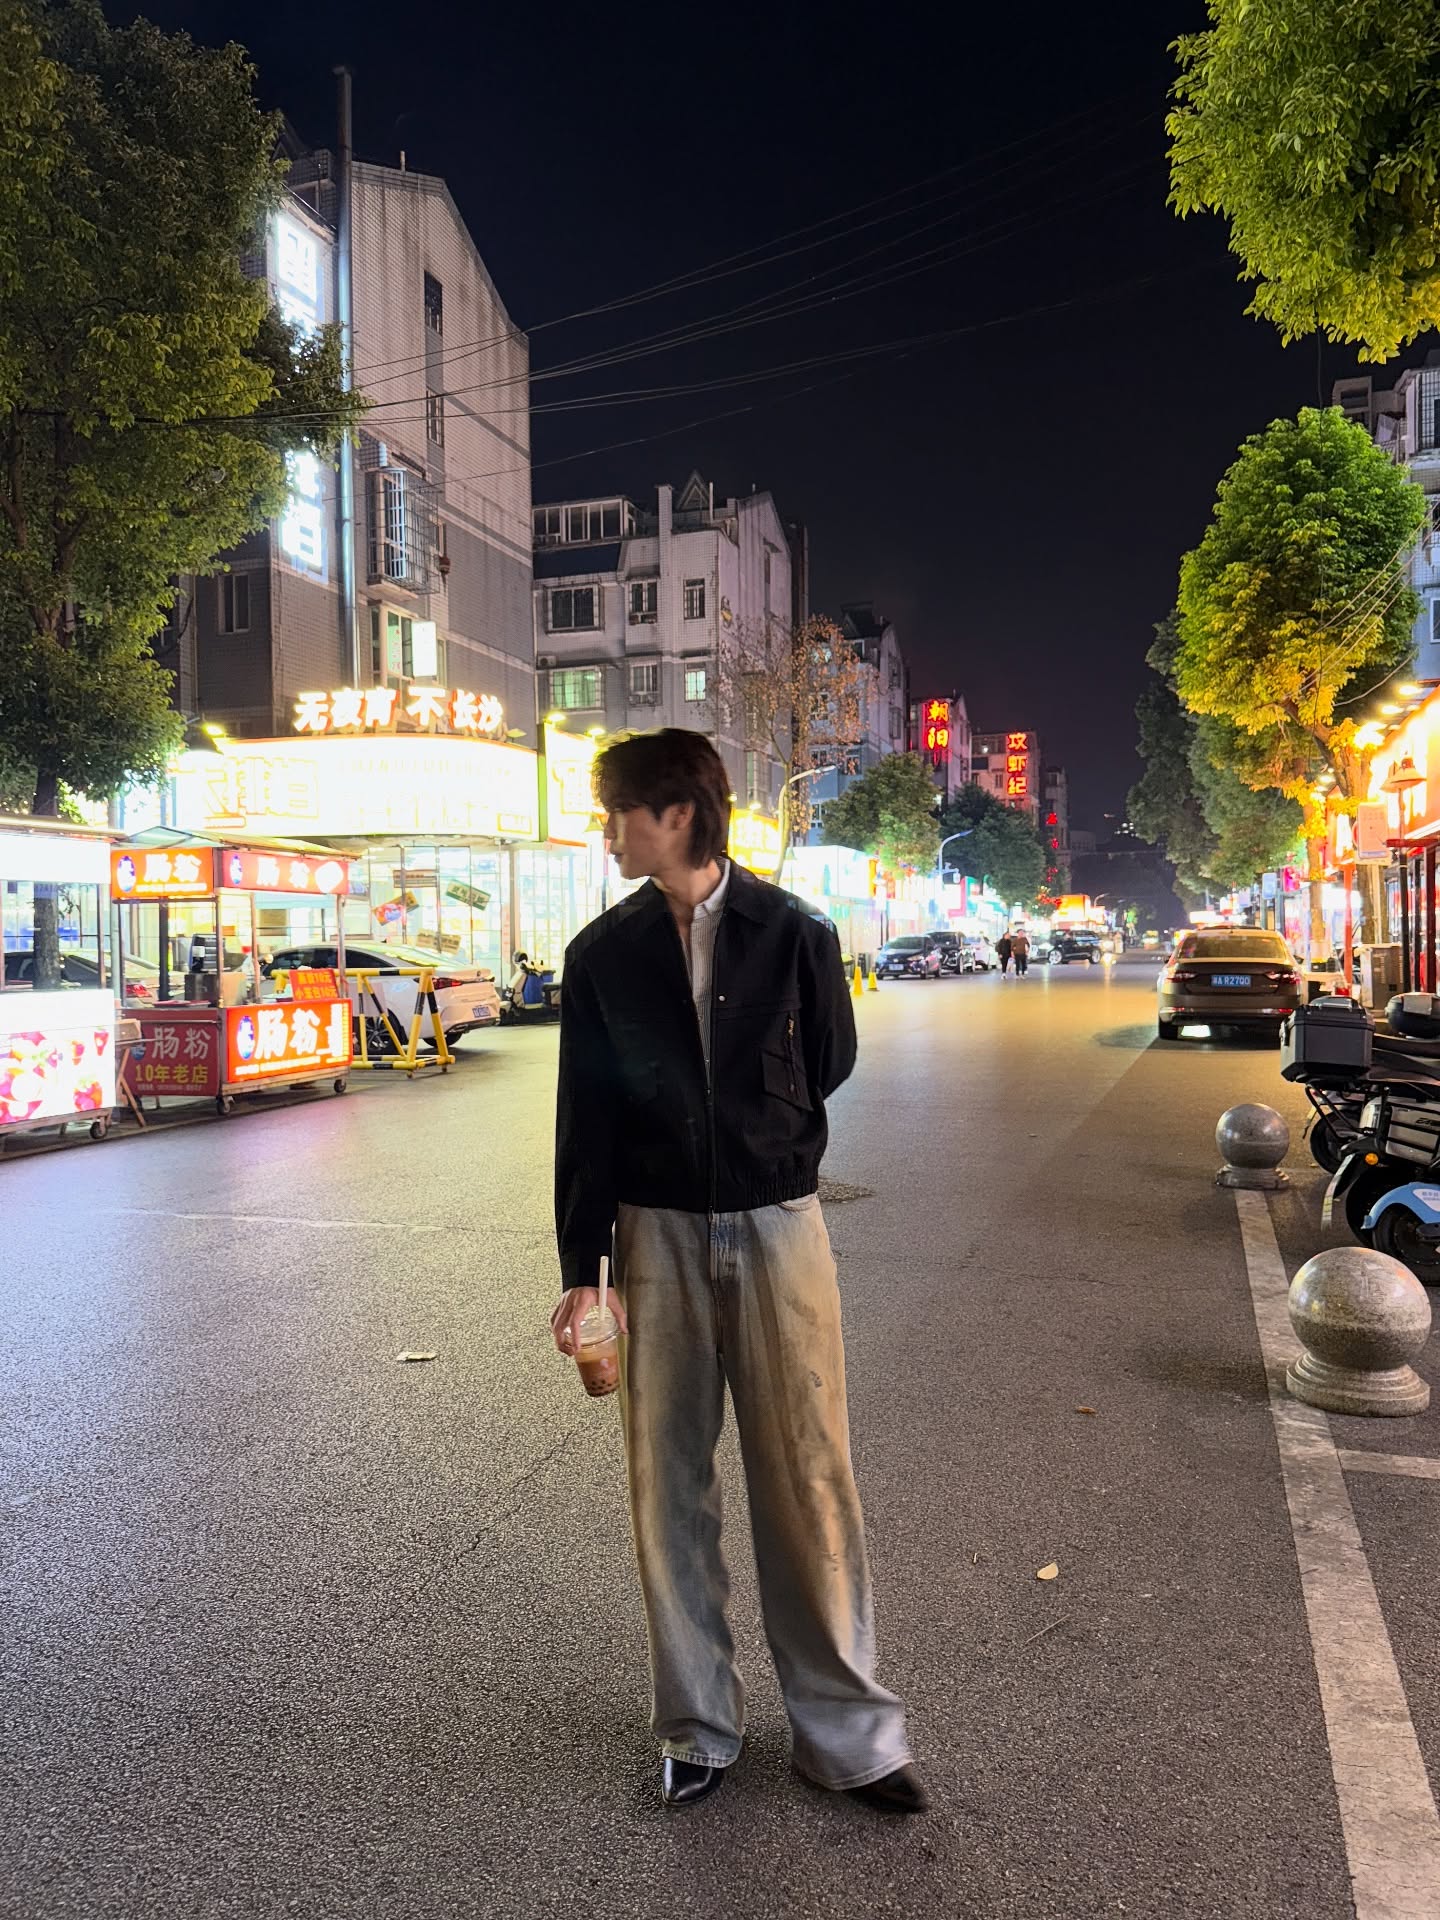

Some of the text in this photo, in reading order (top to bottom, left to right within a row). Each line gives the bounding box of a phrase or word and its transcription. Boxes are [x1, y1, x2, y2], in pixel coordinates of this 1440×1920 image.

[927, 700, 949, 749] 朝阳
[1008, 731, 1028, 795] 攻虾纪
[143, 853, 202, 883] 肠粉
[256, 857, 310, 889] 肠粉
[151, 1026, 212, 1060] 肠粉
[255, 1007, 321, 1060] 肠粉
[135, 1063, 209, 1085] 10年老店
